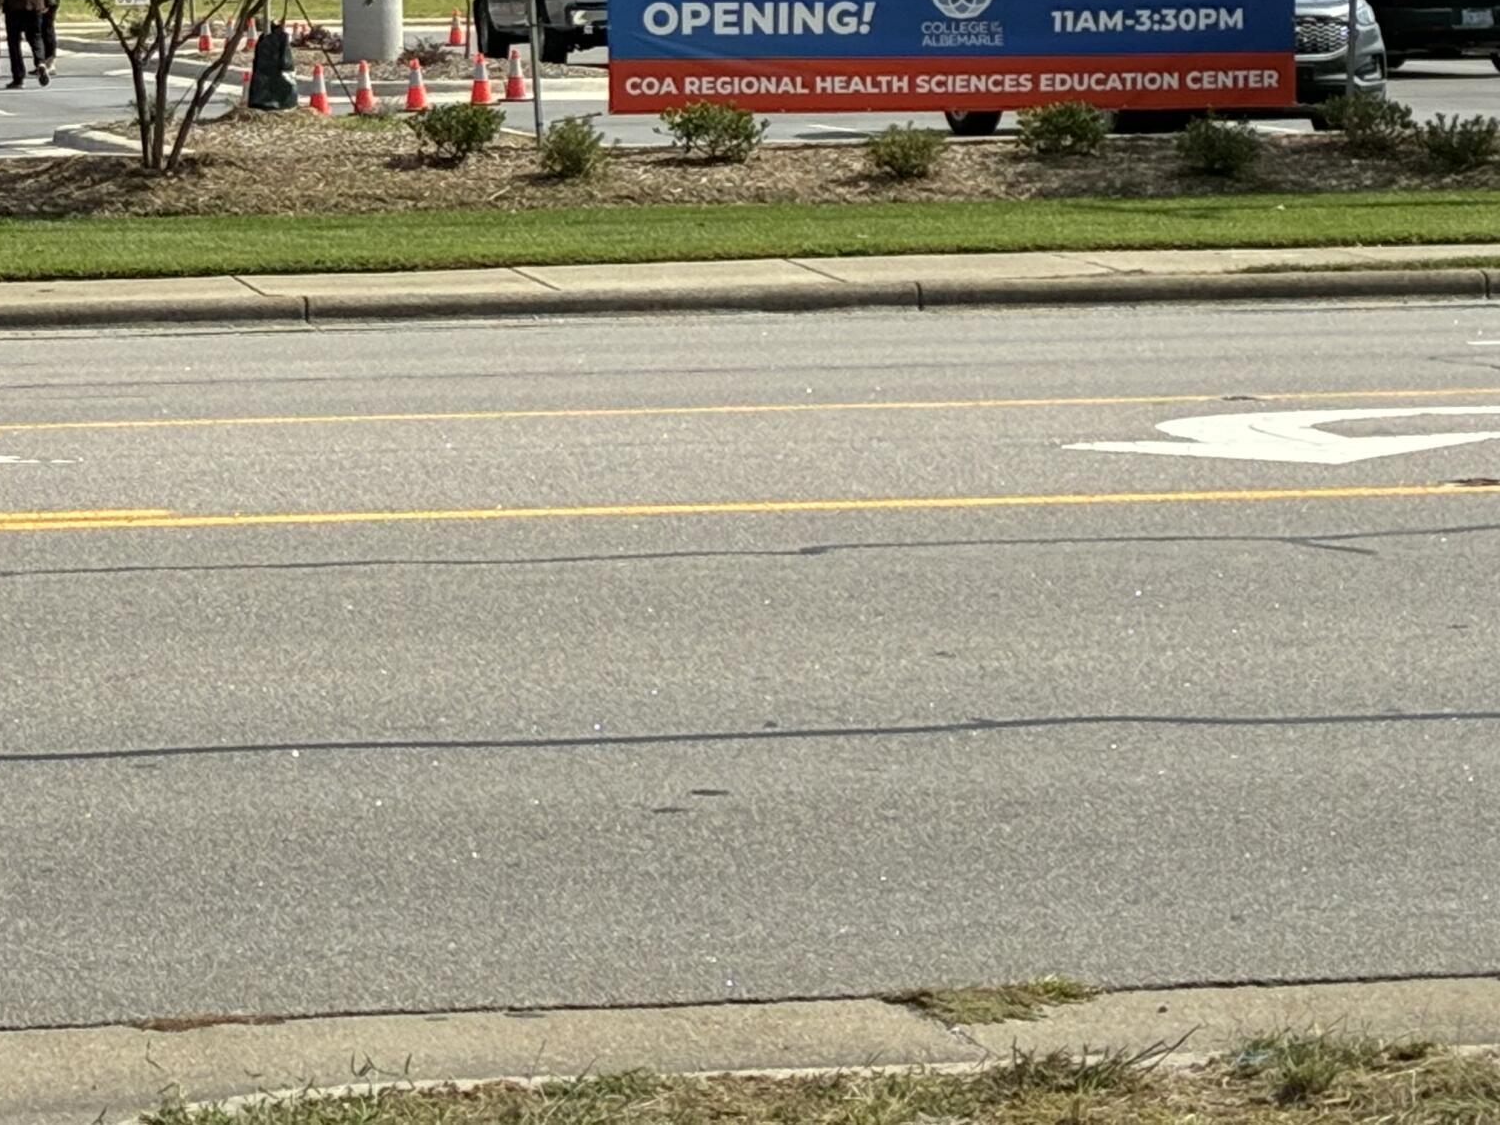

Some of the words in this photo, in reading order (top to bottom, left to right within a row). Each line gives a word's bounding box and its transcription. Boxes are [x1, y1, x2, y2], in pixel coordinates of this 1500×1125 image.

[642, 0, 877, 36] OPENING!
[921, 21, 989, 34] COLLEGE
[1051, 7, 1244, 33] 11AM-3:30PM
[922, 34, 1004, 47] ALBEMARLE
[624, 76, 679, 96] COA
[684, 76, 809, 96] REGIONAL
[815, 75, 909, 94] HEALTH
[915, 74, 1033, 94] SCIENCES
[1039, 72, 1179, 92] EDUCATION
[1185, 70, 1279, 90] CENTER
